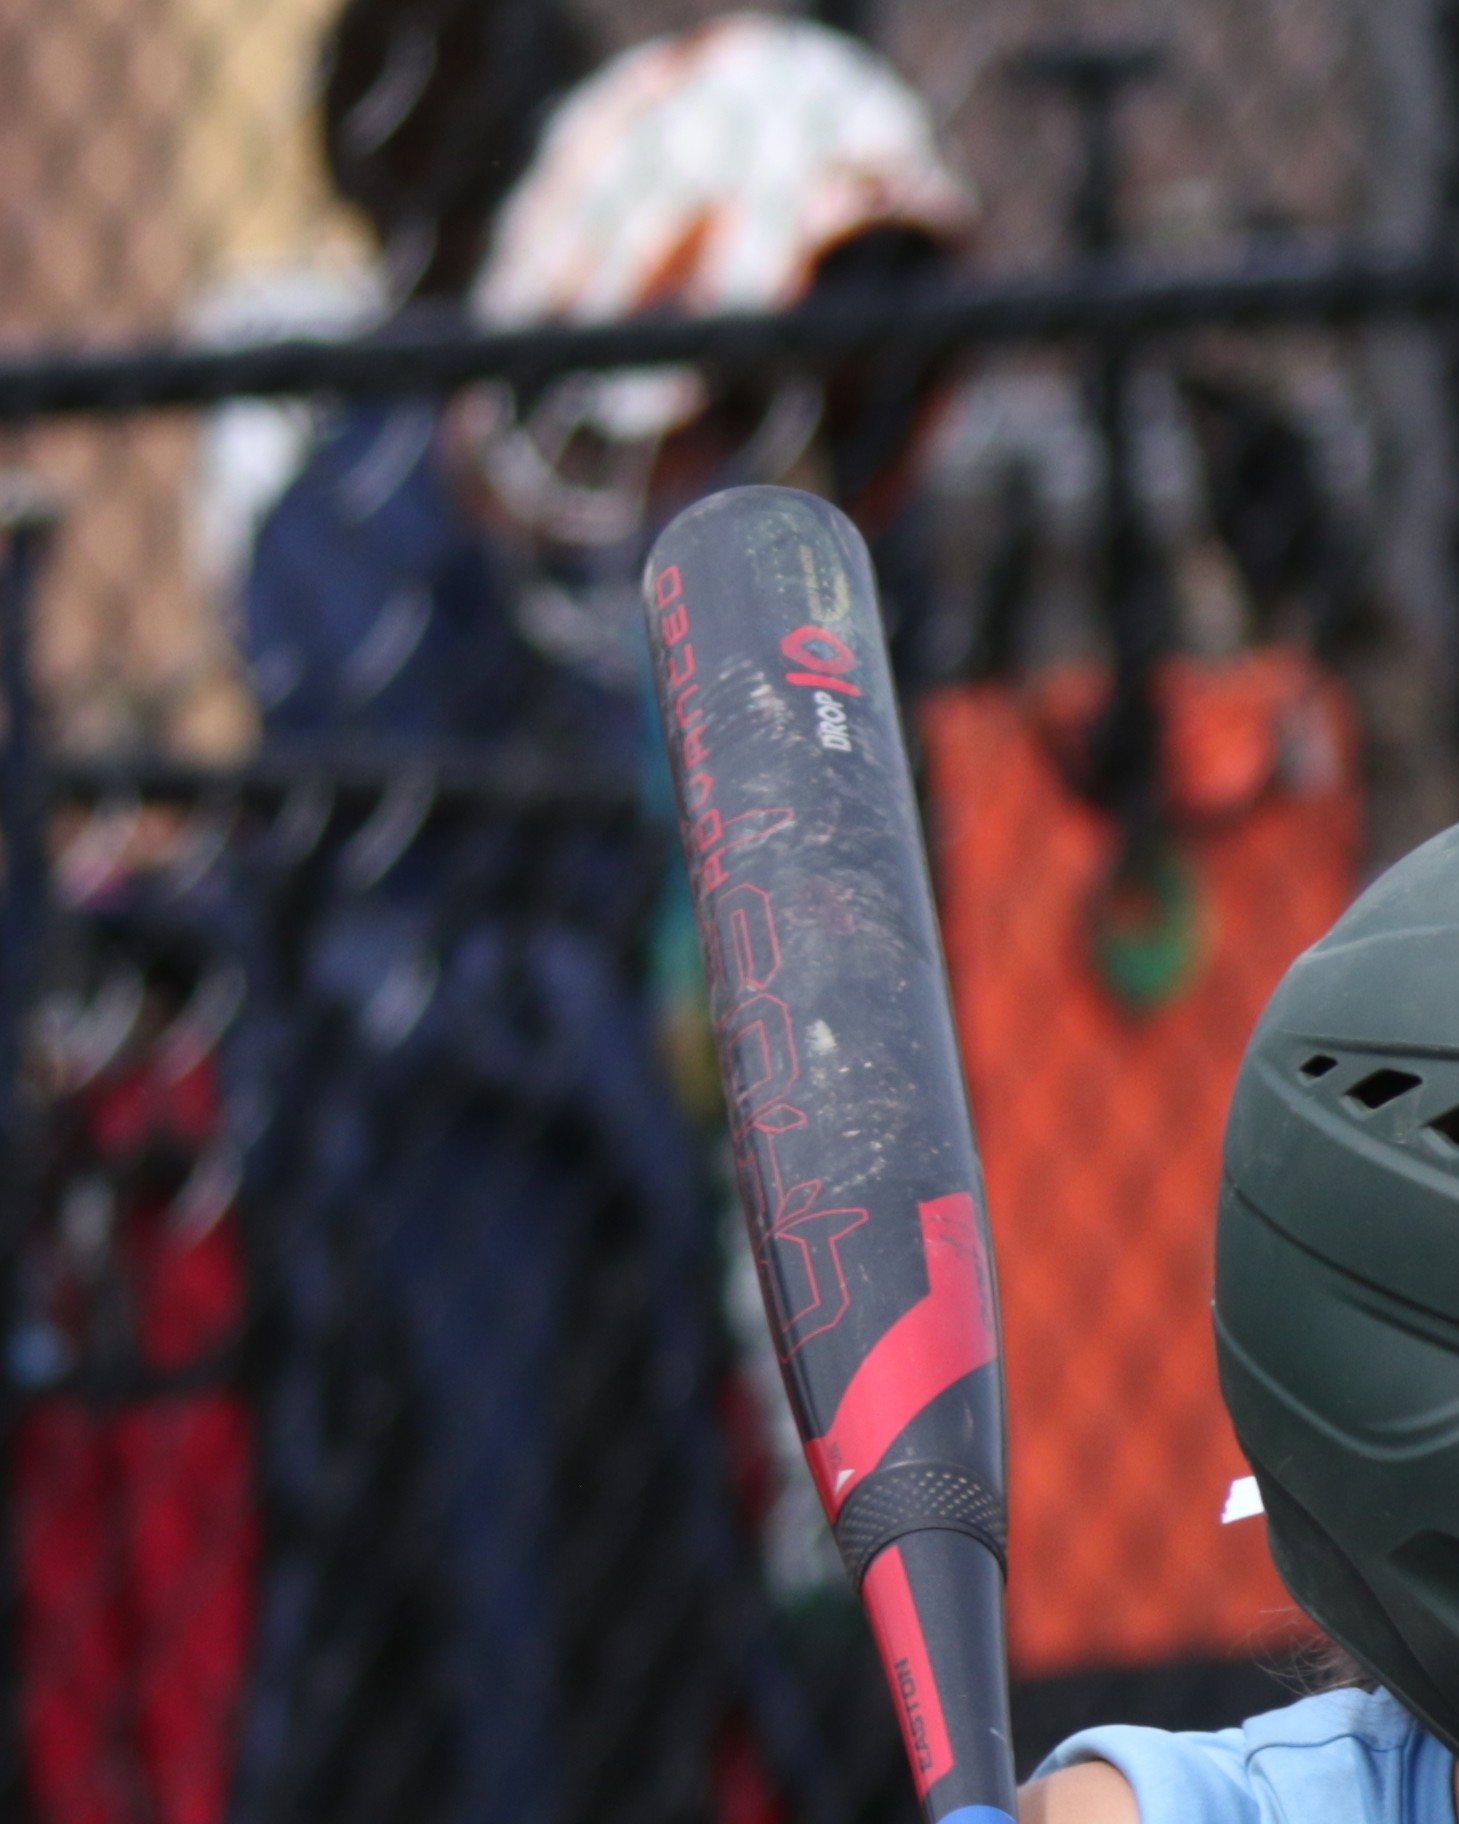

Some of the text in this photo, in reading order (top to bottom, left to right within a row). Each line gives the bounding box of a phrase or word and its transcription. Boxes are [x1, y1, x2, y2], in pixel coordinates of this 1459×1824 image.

[655, 564, 730, 892] ADVANCED
[779, 624, 862, 753] DROP 10
[893, 1657, 933, 1773] EASTON
